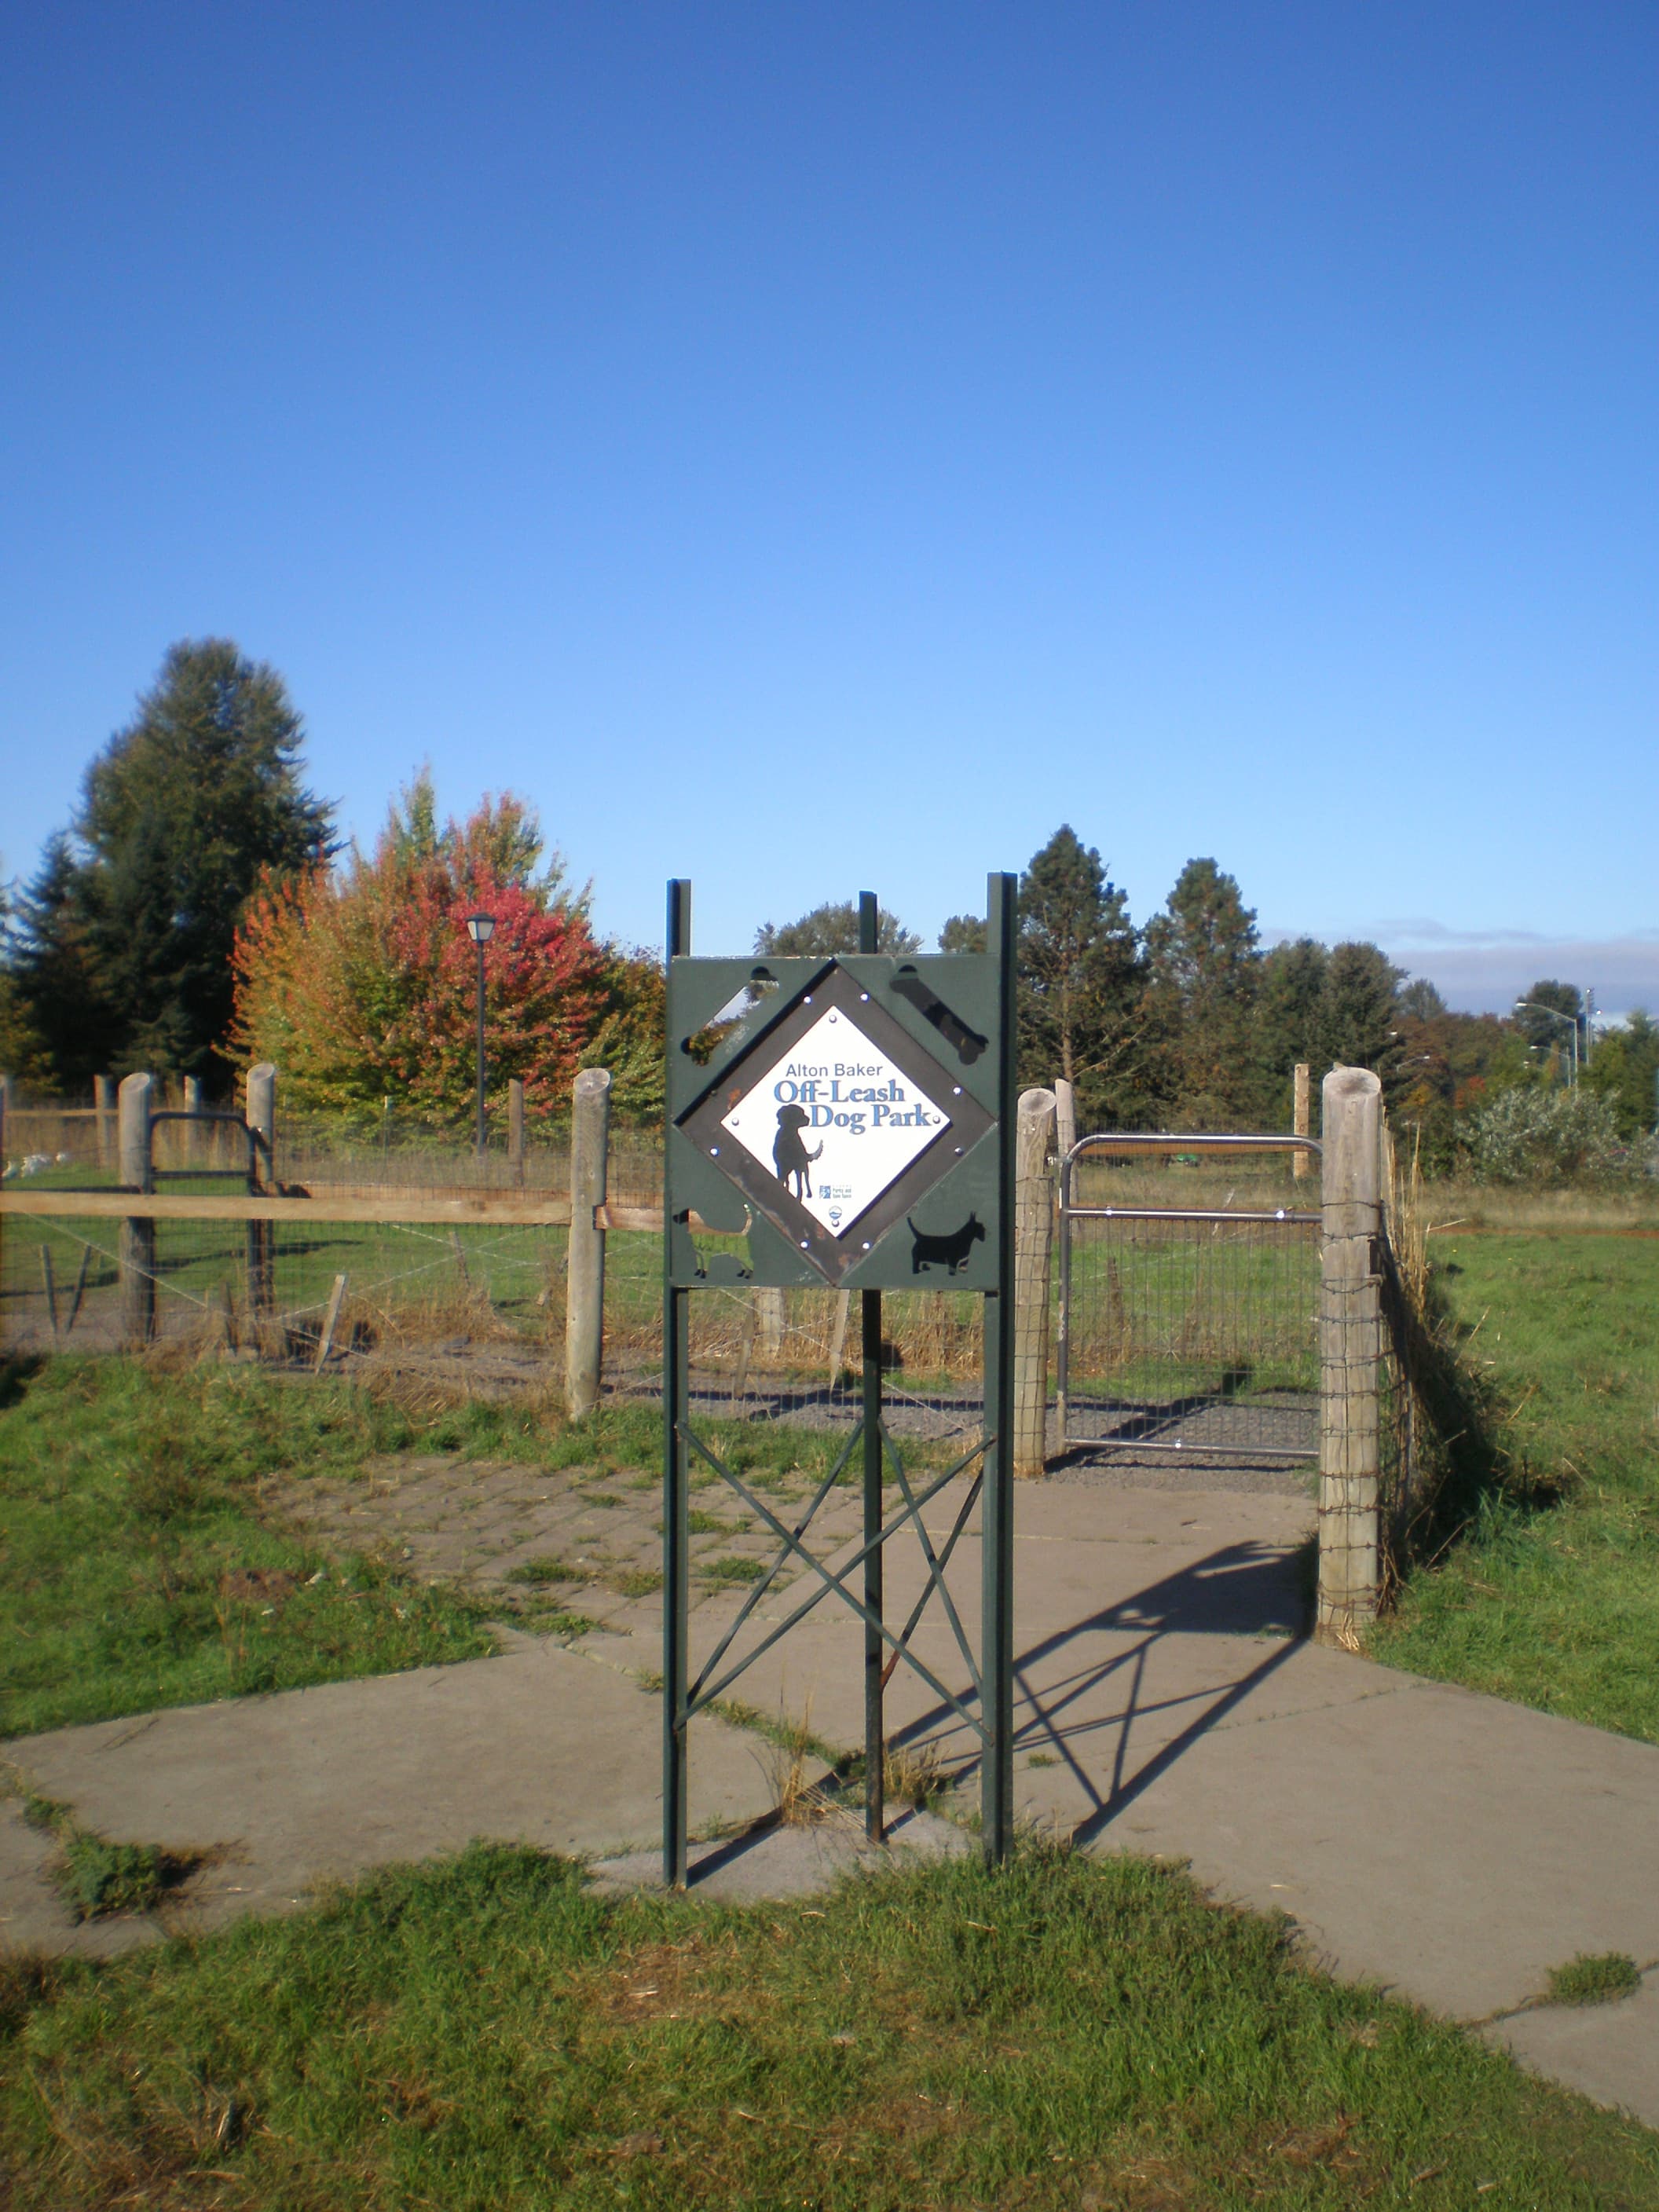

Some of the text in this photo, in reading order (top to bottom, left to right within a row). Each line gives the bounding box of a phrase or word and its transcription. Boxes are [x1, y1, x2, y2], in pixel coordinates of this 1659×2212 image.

[786, 1064, 883, 1077] Alton Baker
[774, 1079, 905, 1103] Off-Leash
[809, 1103, 932, 1135] Dog Park
